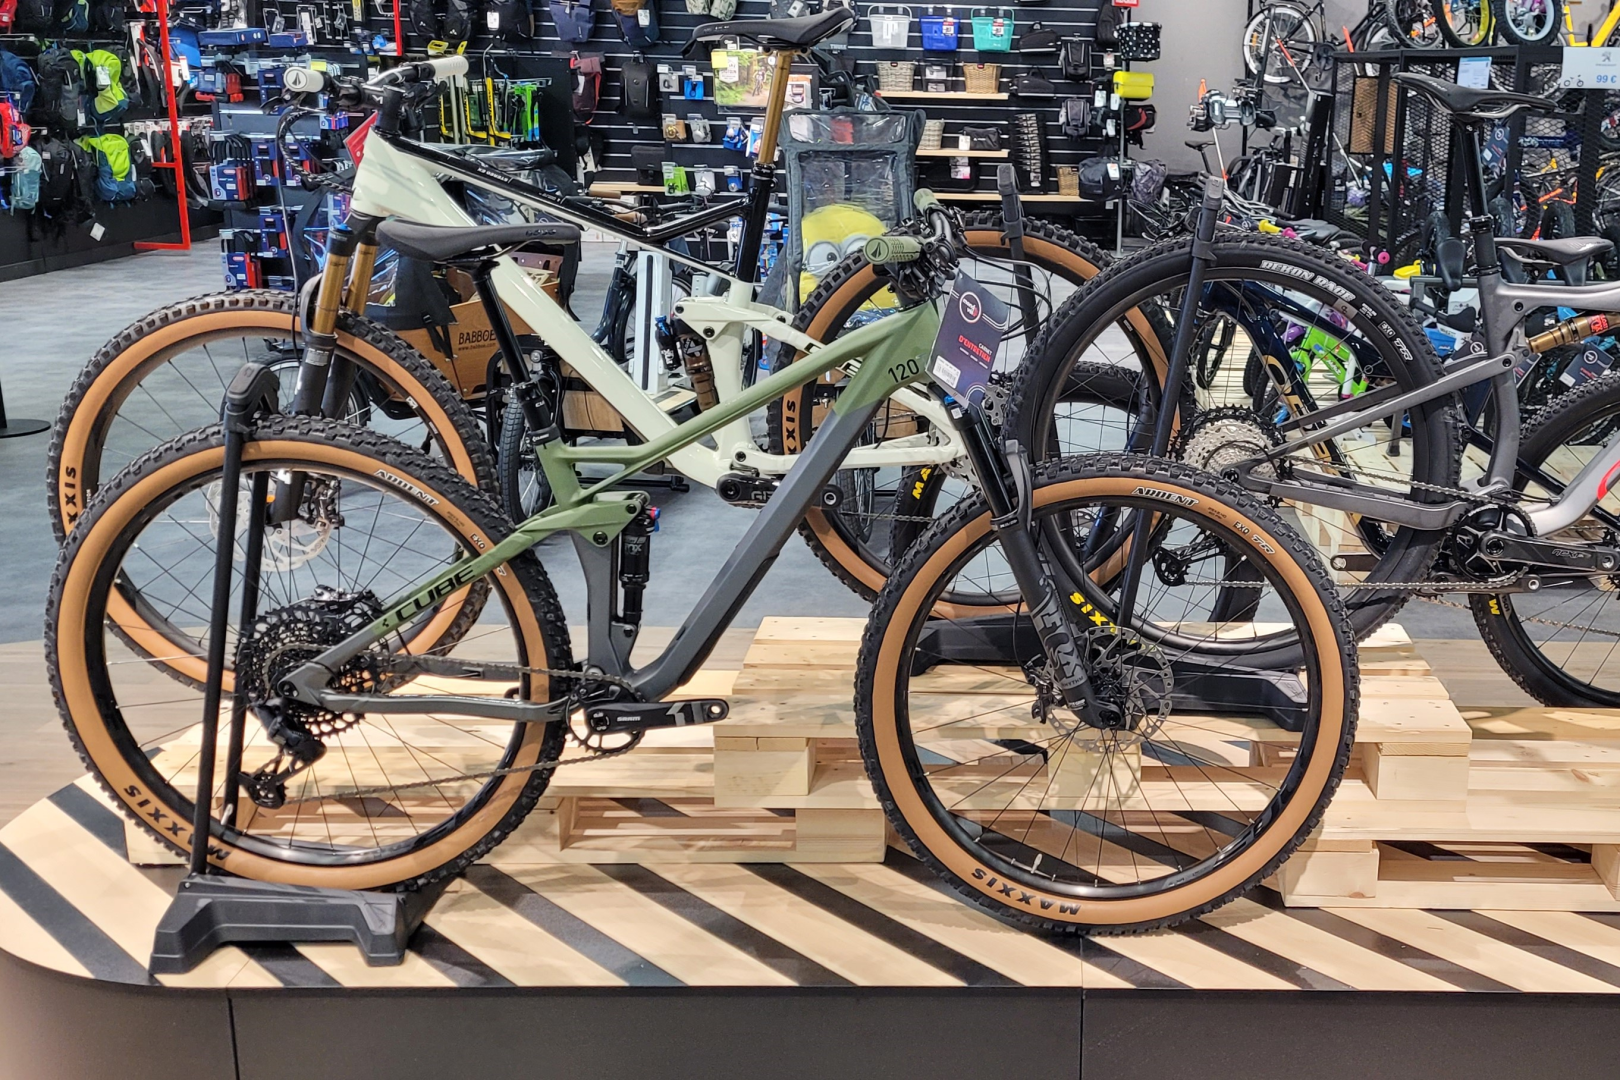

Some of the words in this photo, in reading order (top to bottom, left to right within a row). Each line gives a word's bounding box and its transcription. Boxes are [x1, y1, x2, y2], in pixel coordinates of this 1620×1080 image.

[1596, 74, 1608, 83] 99
[1610, 75, 1617, 83] €
[458, 329, 497, 345] BABBOE
[1380, 322, 1394, 337] EXO
[887, 358, 920, 383] 120
[1132, 486, 1199, 507] ARDENT
[471, 533, 486, 550] EXO
[1234, 520, 1250, 535] EXO
[1251, 533, 1276, 554] TR
[395, 565, 476, 622] CUBE
[971, 867, 1082, 916] MAXXIS
